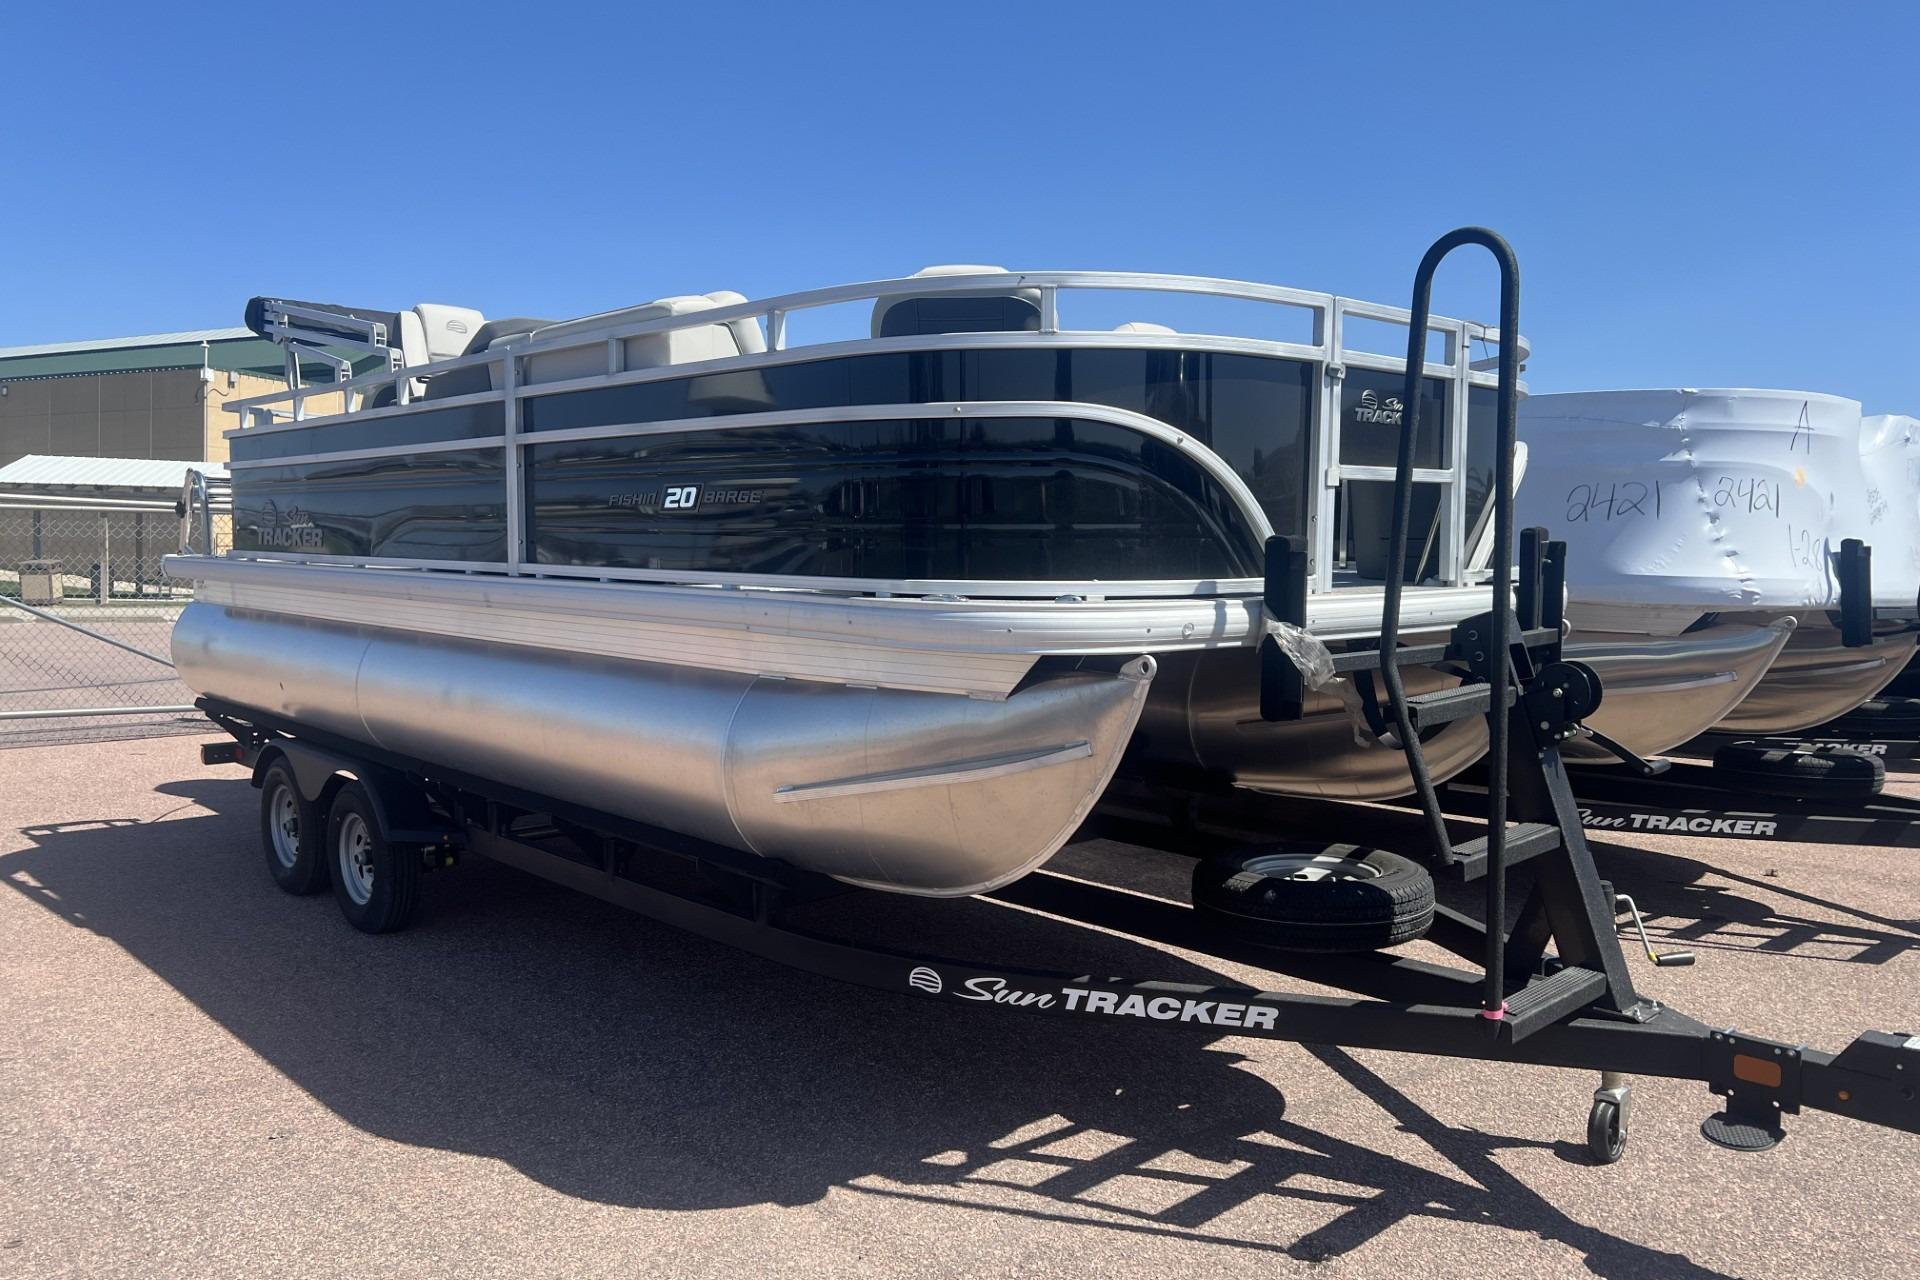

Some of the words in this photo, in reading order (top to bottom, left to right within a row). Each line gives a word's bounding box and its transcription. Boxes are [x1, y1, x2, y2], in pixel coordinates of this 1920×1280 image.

[1355, 407, 1403, 425] TRACK
[1791, 400, 1814, 454] A
[664, 487, 697, 508] 20
[704, 490, 762, 503] BARGE
[1566, 480, 1660, 522] 2421
[1714, 476, 1779, 519] 2421
[256, 527, 324, 547] TRACKER
[1629, 813, 1778, 836] TRACKER
[953, 977, 1057, 1009] Sun
[1061, 987, 1280, 1031] TRACKER
